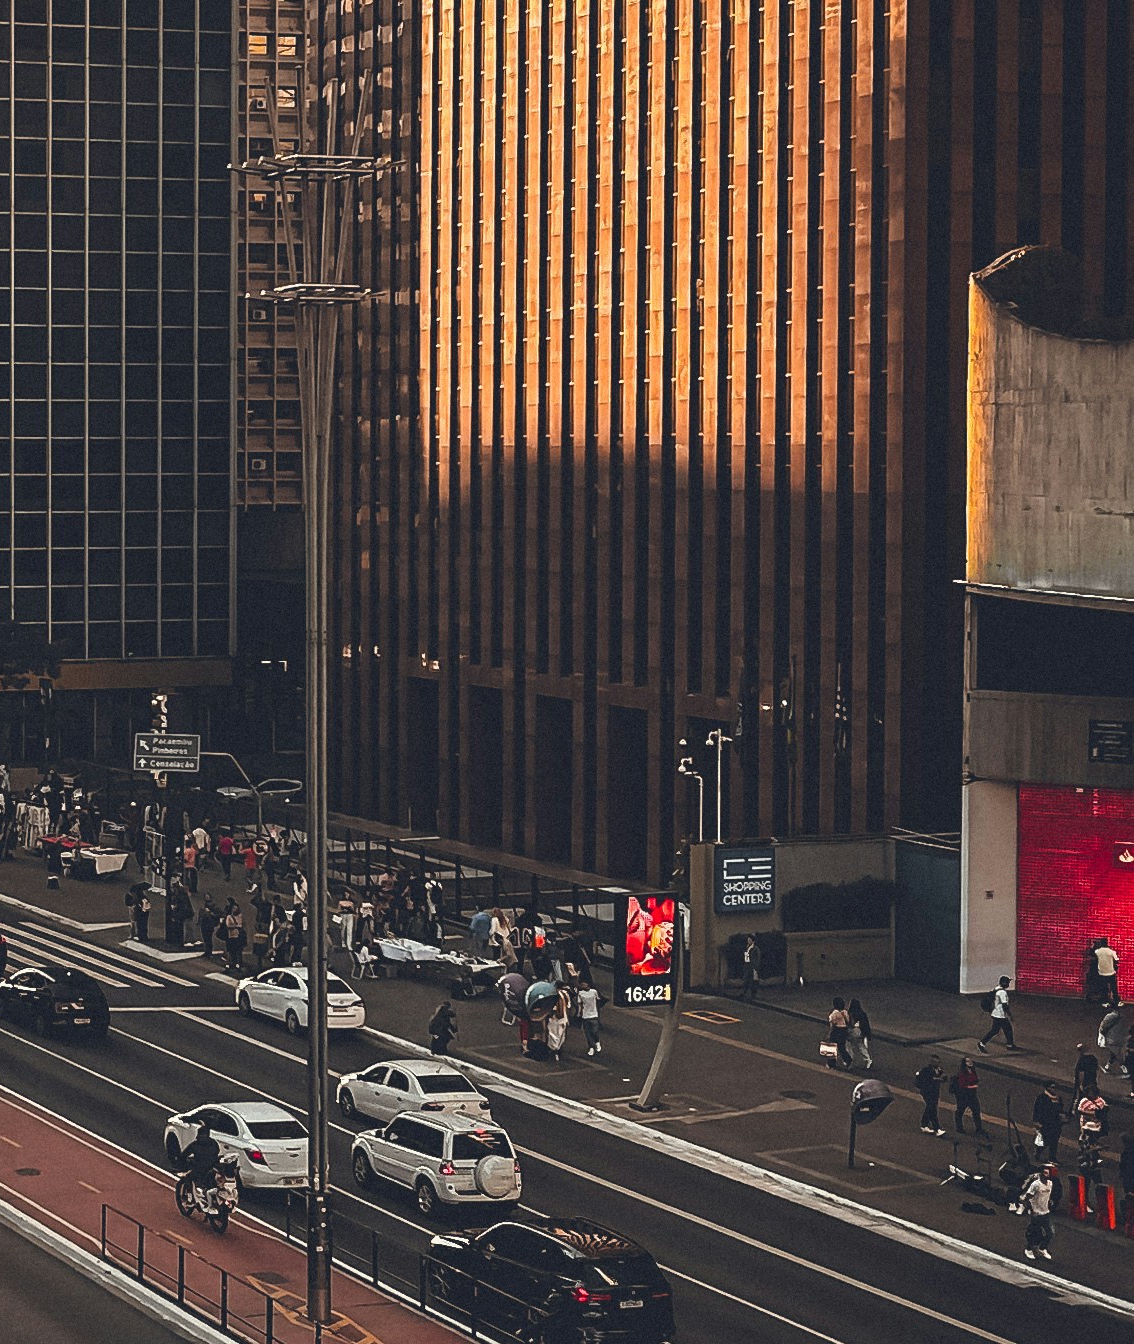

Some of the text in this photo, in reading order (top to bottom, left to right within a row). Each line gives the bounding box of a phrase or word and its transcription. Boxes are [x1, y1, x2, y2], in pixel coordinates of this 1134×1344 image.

[152, 737, 193, 746] Pacaembu
[152, 746, 188, 755] Pinheiros
[149, 759, 195, 769] Consolação
[723, 881, 771, 892] SHOPPING
[723, 893, 763, 905] CENTER
